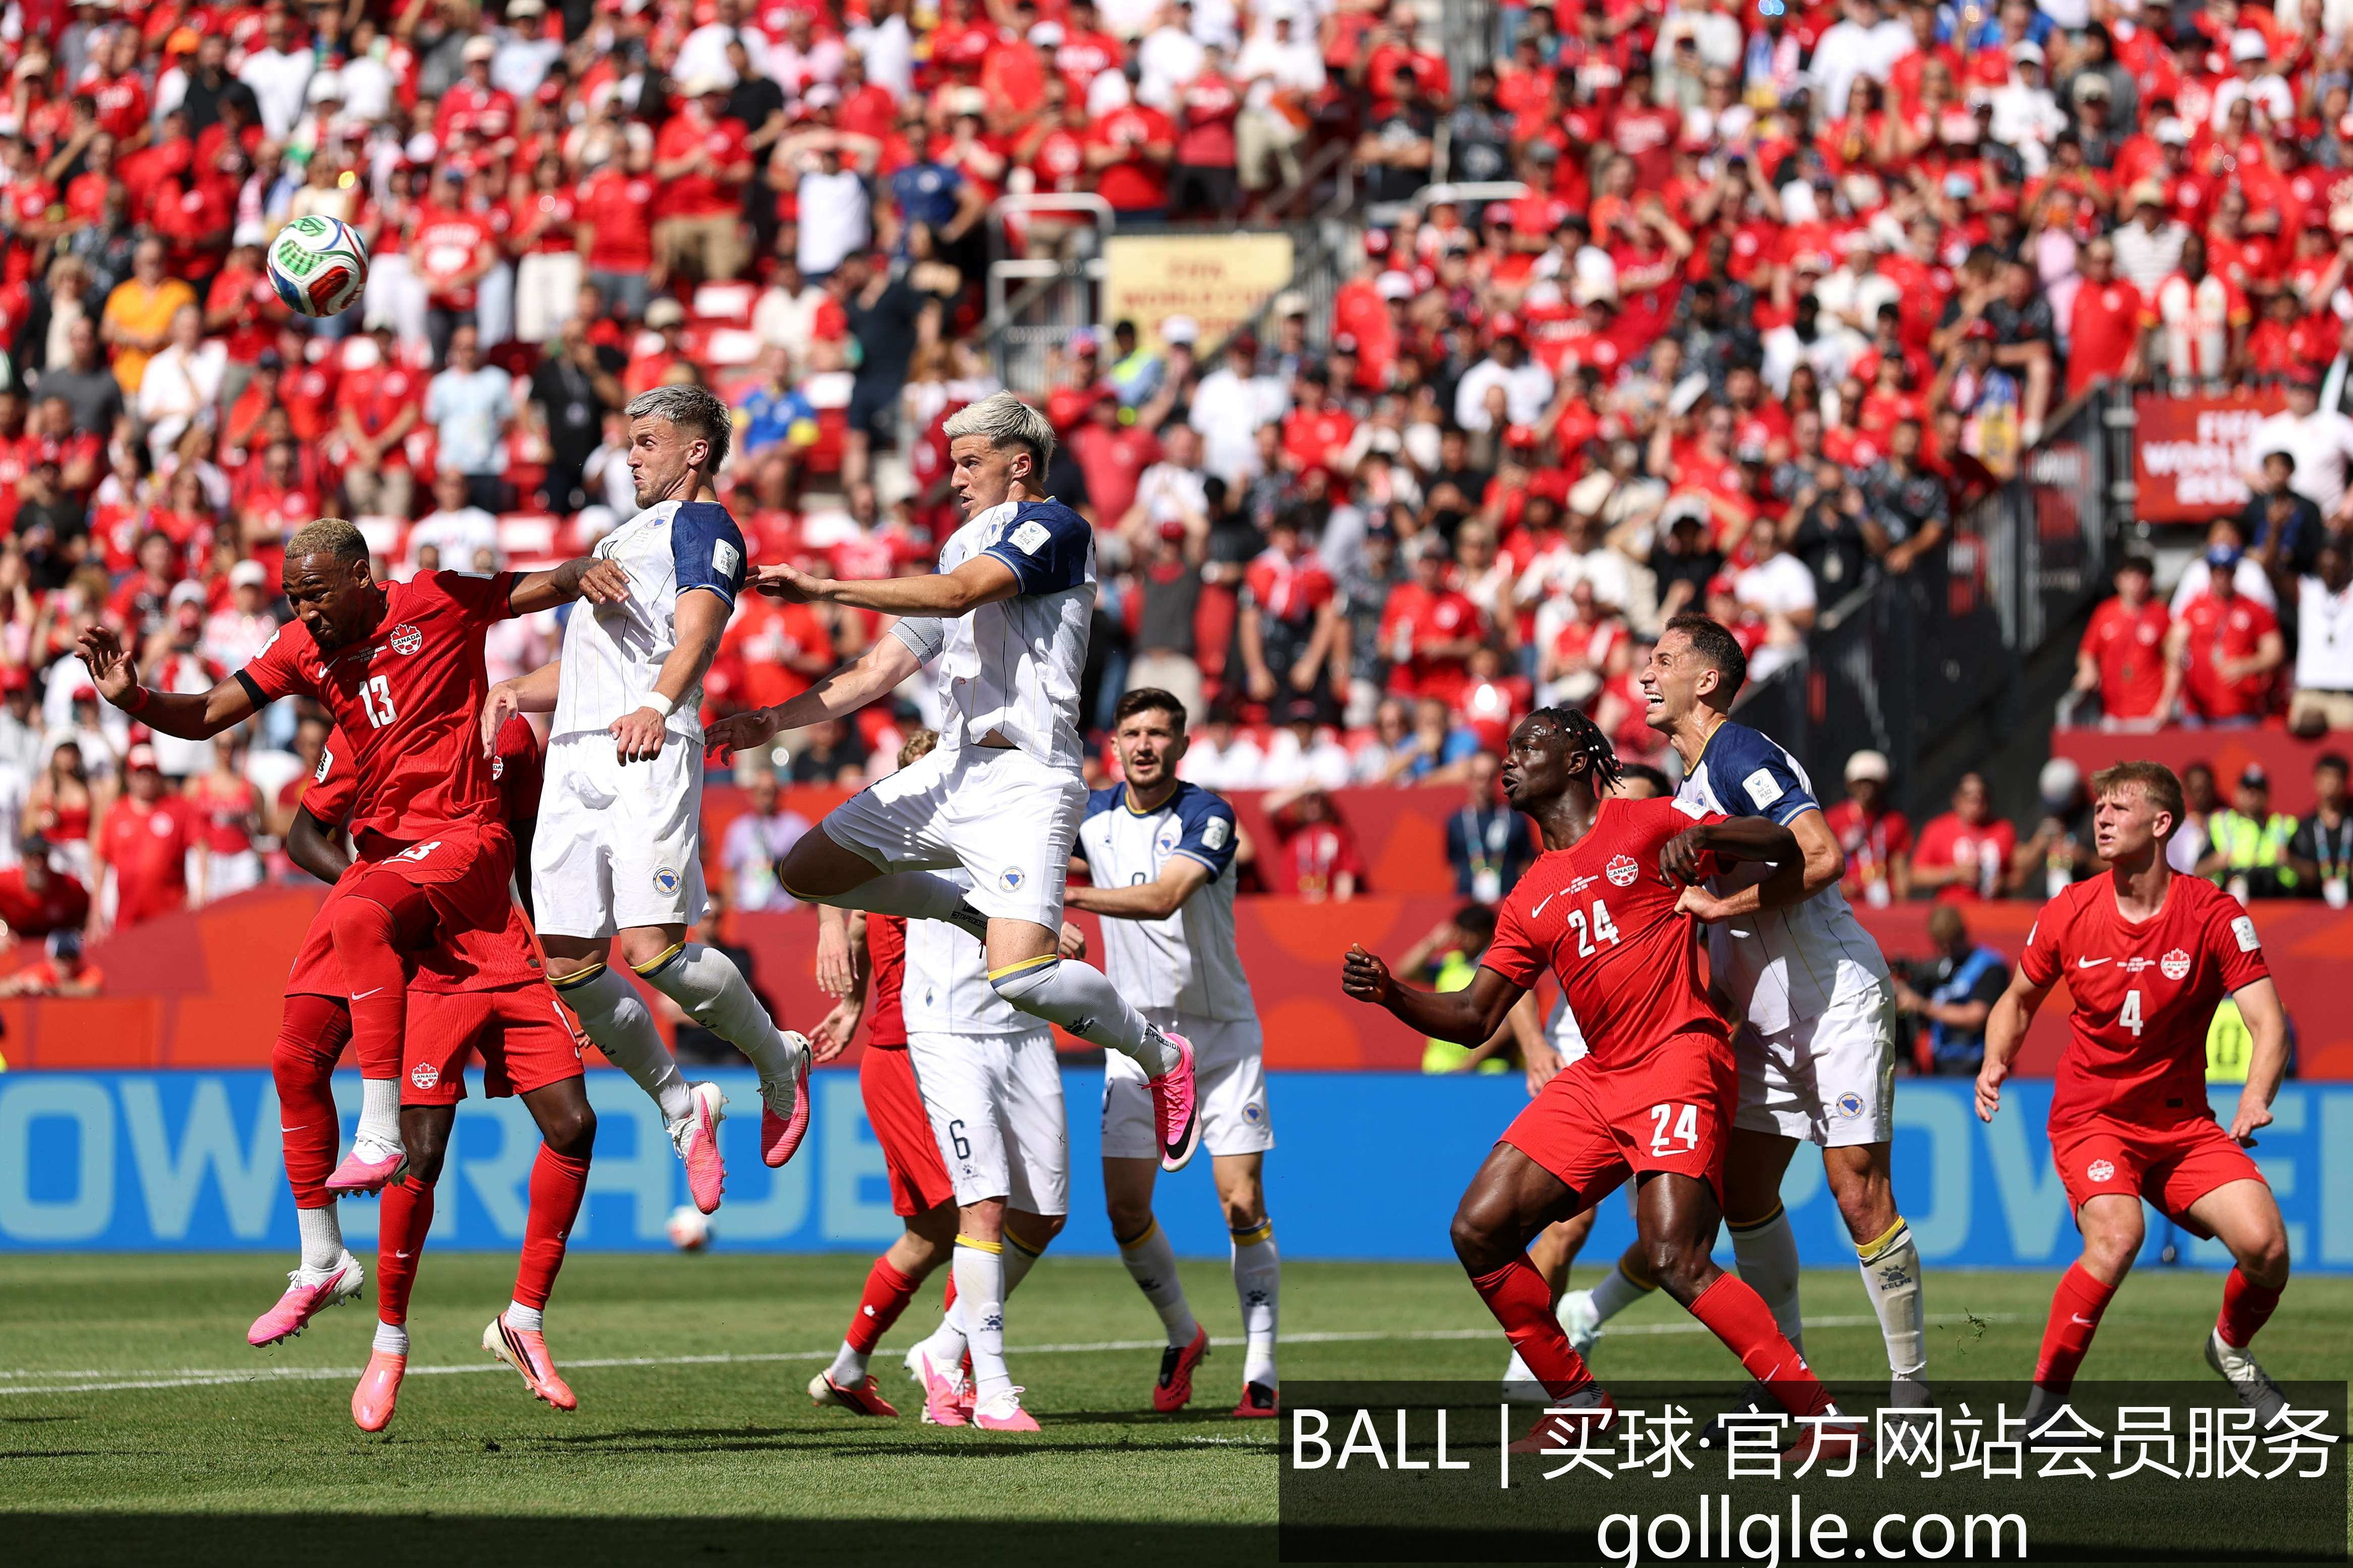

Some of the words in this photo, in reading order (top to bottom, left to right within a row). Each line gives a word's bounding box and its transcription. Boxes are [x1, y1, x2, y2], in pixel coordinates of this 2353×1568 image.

[392, 633, 421, 646] CANADA
[359, 674, 398, 728] 13
[1608, 865, 1637, 876] CANADA
[1567, 899, 1620, 958] 24
[2119, 989, 2143, 1036] 4
[1149, 1028, 1181, 1053] TAPEDESIGN
[950, 1119, 970, 1160] 6
[1650, 1104, 1699, 1150] 24
